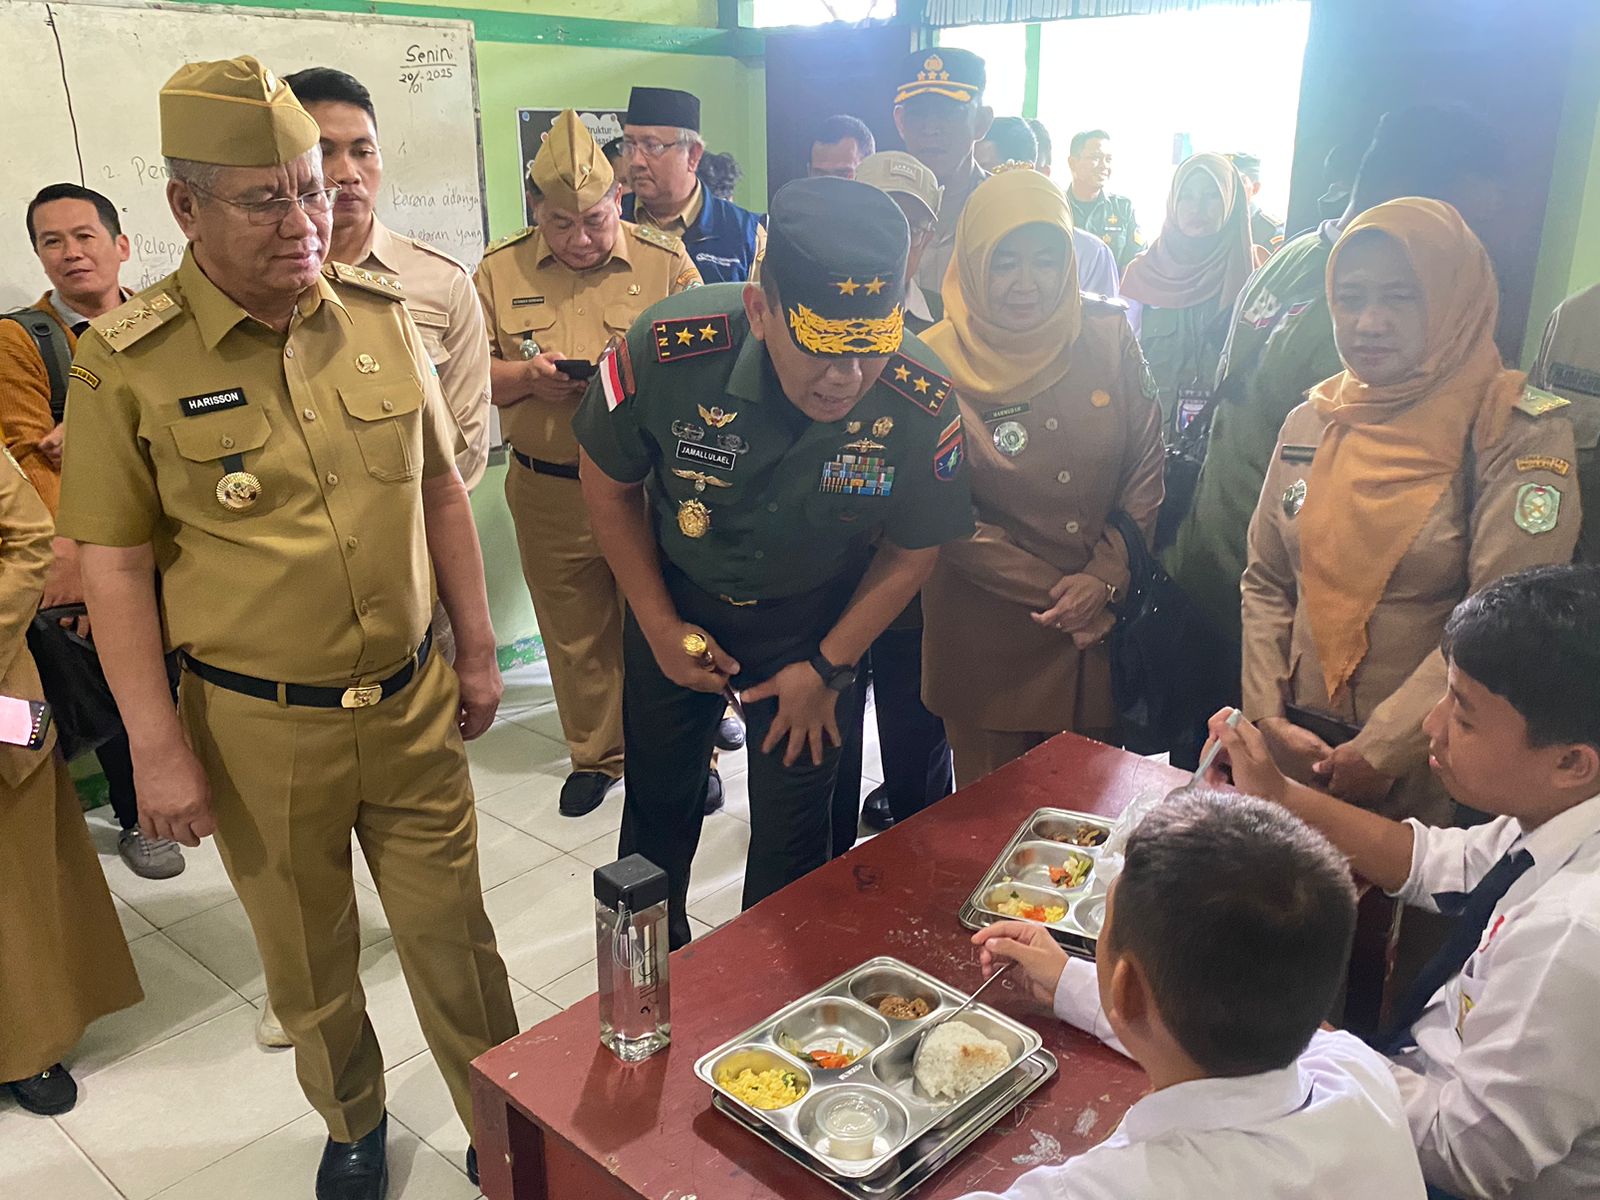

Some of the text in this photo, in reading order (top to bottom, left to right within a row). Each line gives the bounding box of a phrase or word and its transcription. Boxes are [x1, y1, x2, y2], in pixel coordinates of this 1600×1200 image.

[405, 44, 453, 63] Senin
[455, 228, 483, 247] yang
[656, 323, 671, 357] TNI
[188, 391, 239, 410] HARISSON
[681, 446, 730, 465] JAMALLULAEL
